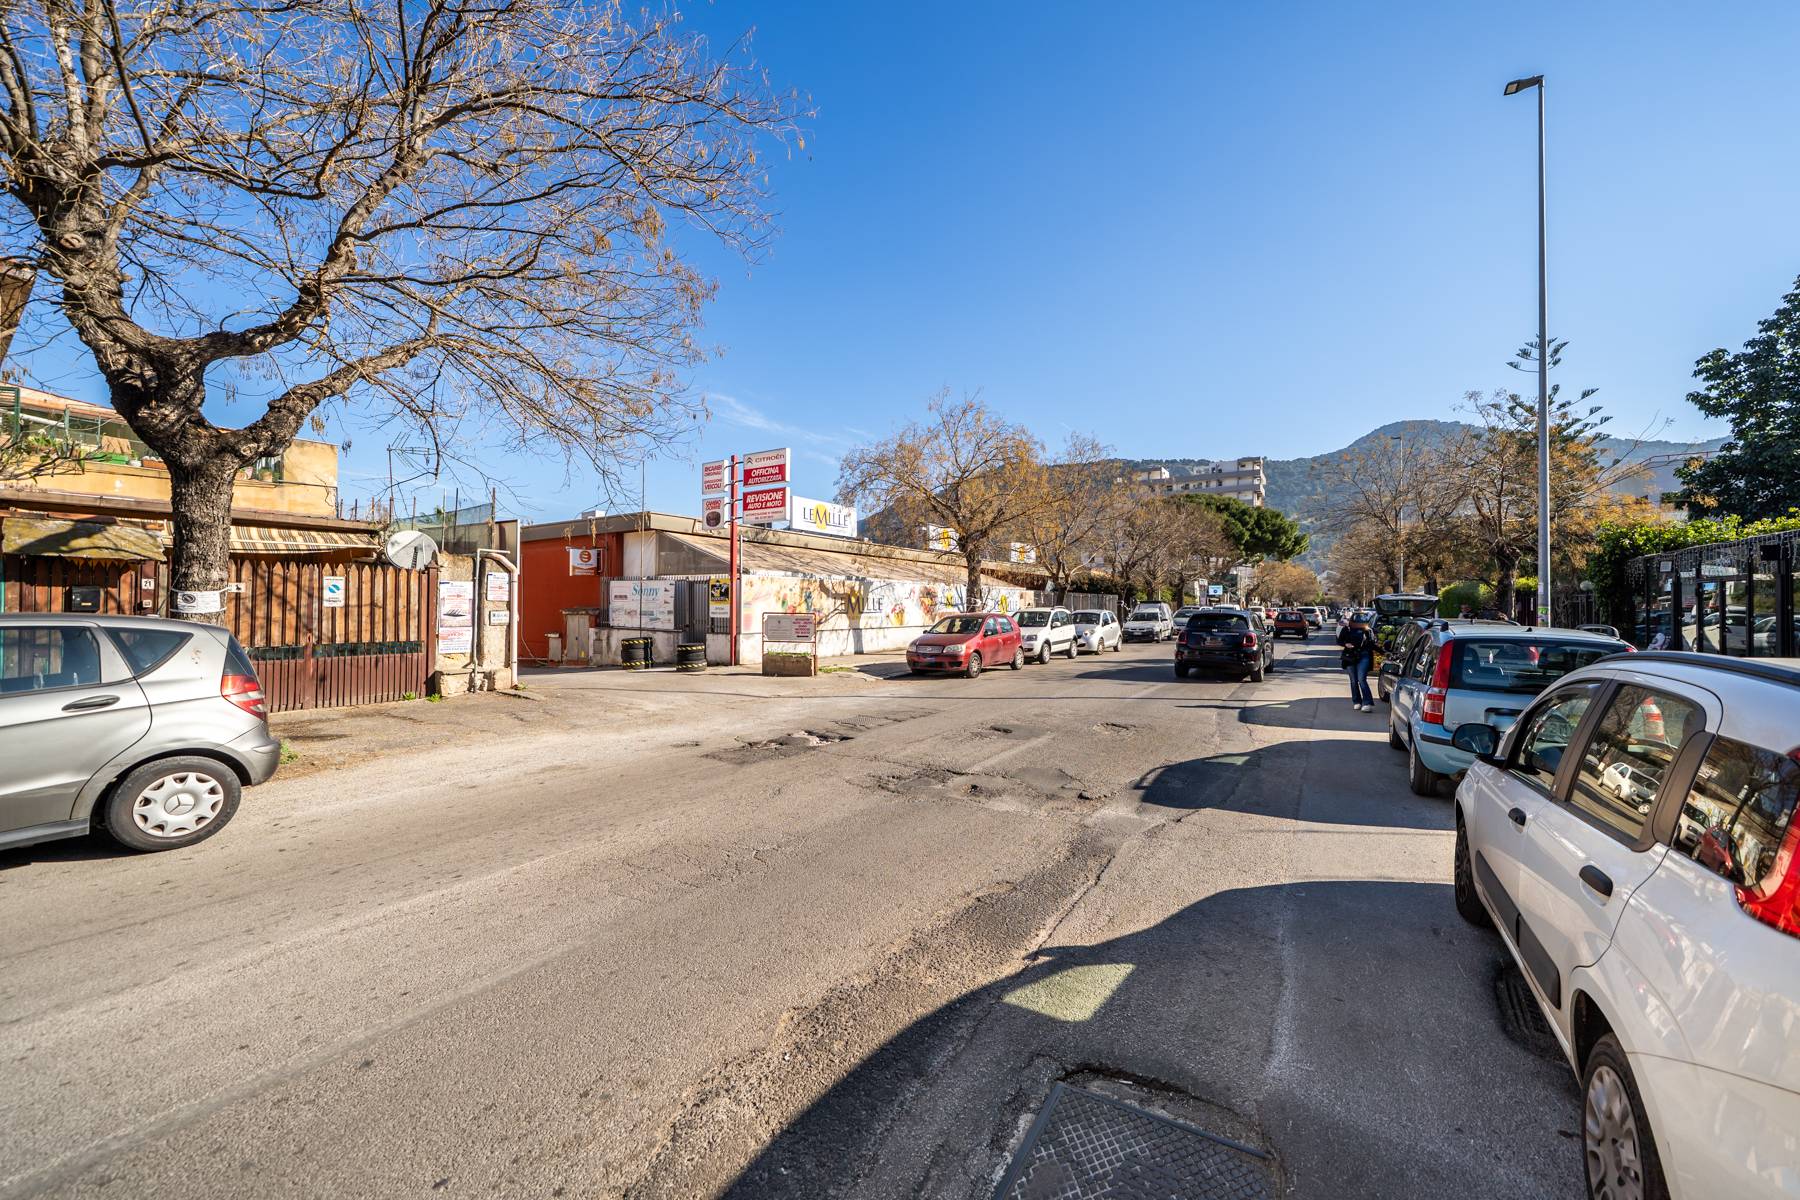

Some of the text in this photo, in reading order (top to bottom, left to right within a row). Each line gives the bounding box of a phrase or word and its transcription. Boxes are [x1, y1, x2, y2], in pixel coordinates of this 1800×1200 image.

[751, 466, 779, 477] OFFICINA
[748, 474, 782, 485] AUTORIZZATA
[746, 491, 783, 503] REVISIONE
